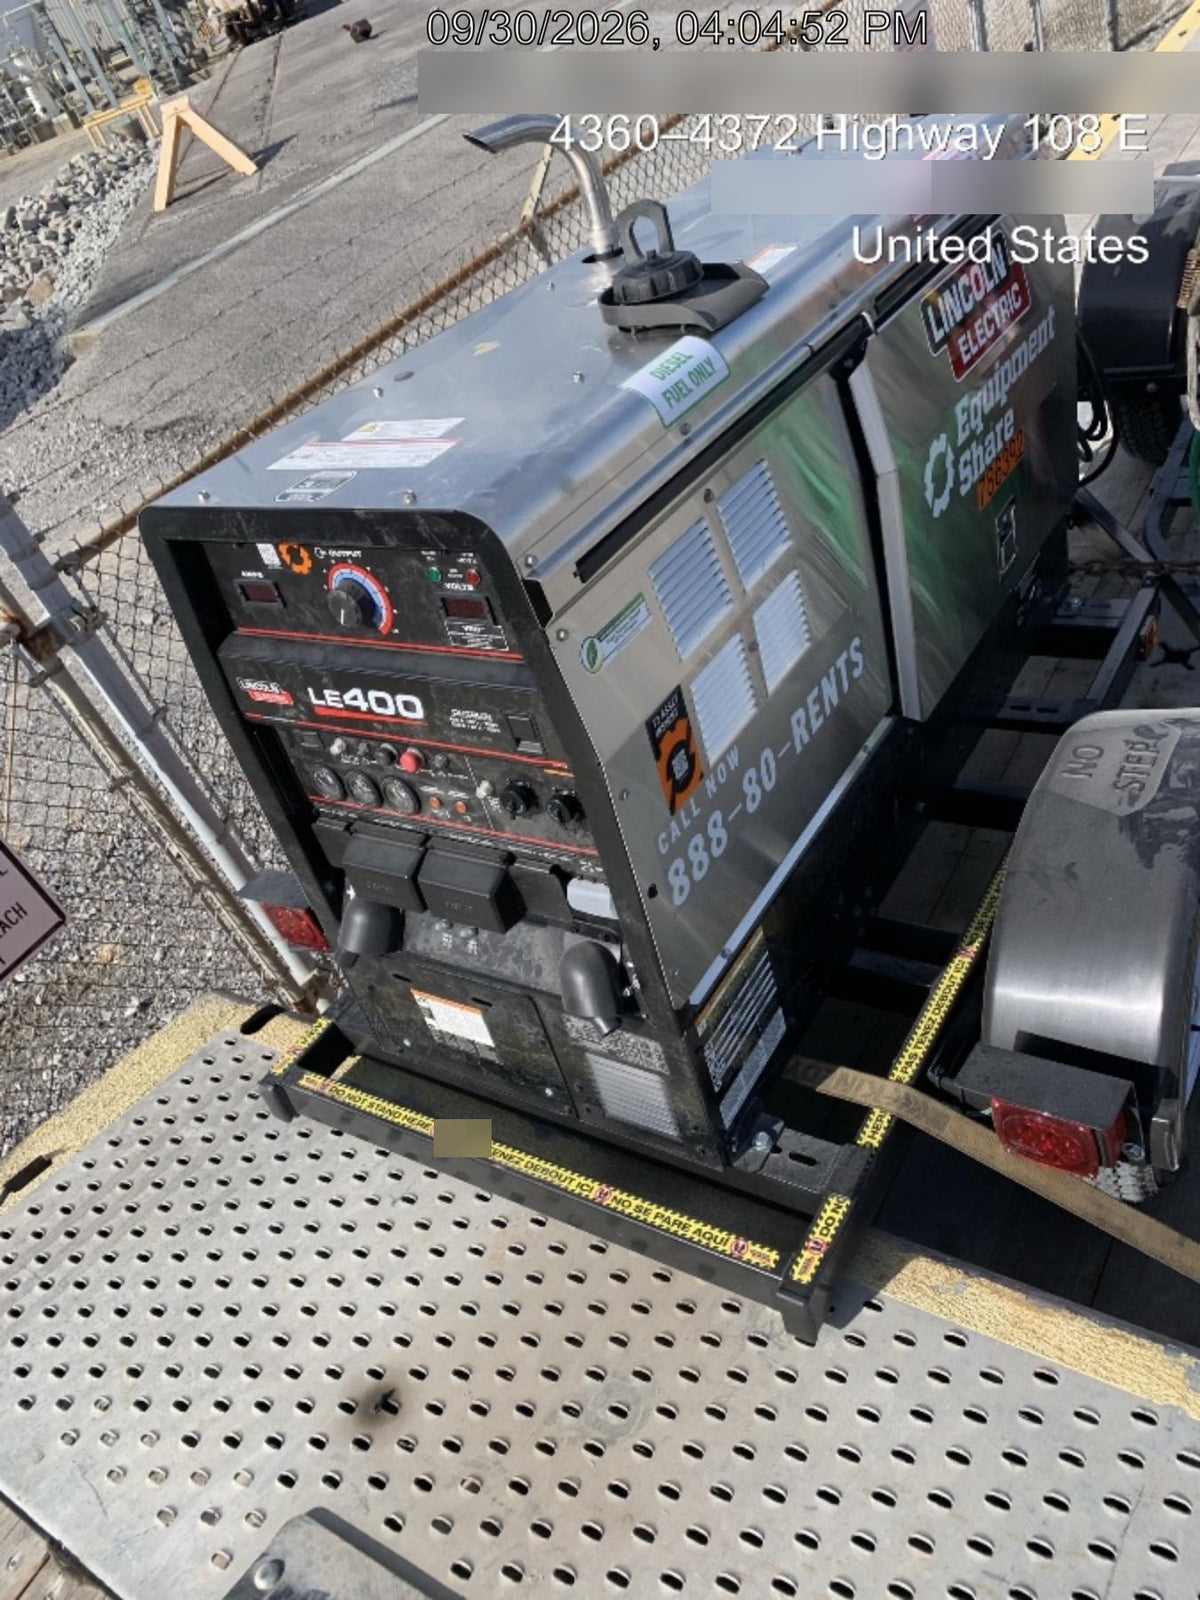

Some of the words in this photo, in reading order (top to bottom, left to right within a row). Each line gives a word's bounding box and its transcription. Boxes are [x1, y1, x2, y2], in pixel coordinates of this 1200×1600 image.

[927, 243, 1007, 343] LINCOLN
[957, 282, 1022, 365] ELECTRIC
[649, 351, 694, 381] DIESEL
[661, 378, 693, 409] FUEL
[687, 356, 717, 387] ONLY
[955, 304, 1055, 446] Equipment
[958, 408, 1014, 496] Share
[307, 686, 424, 720] LE400
[1061, 744, 1105, 778] NO
[1112, 738, 1160, 793] STEP
[658, 797, 702, 854] CALL
[704, 745, 739, 798] NOW
[0, 901, 28, 939] ACH
[900, 1053, 918, 1076] PAS
[914, 1017, 938, 1051] TENEZ
[931, 974, 956, 1016] DEBOUT
[328, 1085, 346, 1097] DO
[345, 1091, 367, 1106] NOT
[366, 1101, 402, 1120] STAND
[400, 1111, 432, 1132] HERE
[491, 1146, 525, 1167] ENEZ
[524, 1159, 577, 1186] DEBOUT
[575, 1179, 595, 1195] ICI
[611, 1195, 633, 1209] NO
[632, 1203, 653, 1217] SE
[653, 1212, 693, 1233] PARE
[819, 1214, 837, 1238] DO
[833, 1194, 848, 1213] NO
